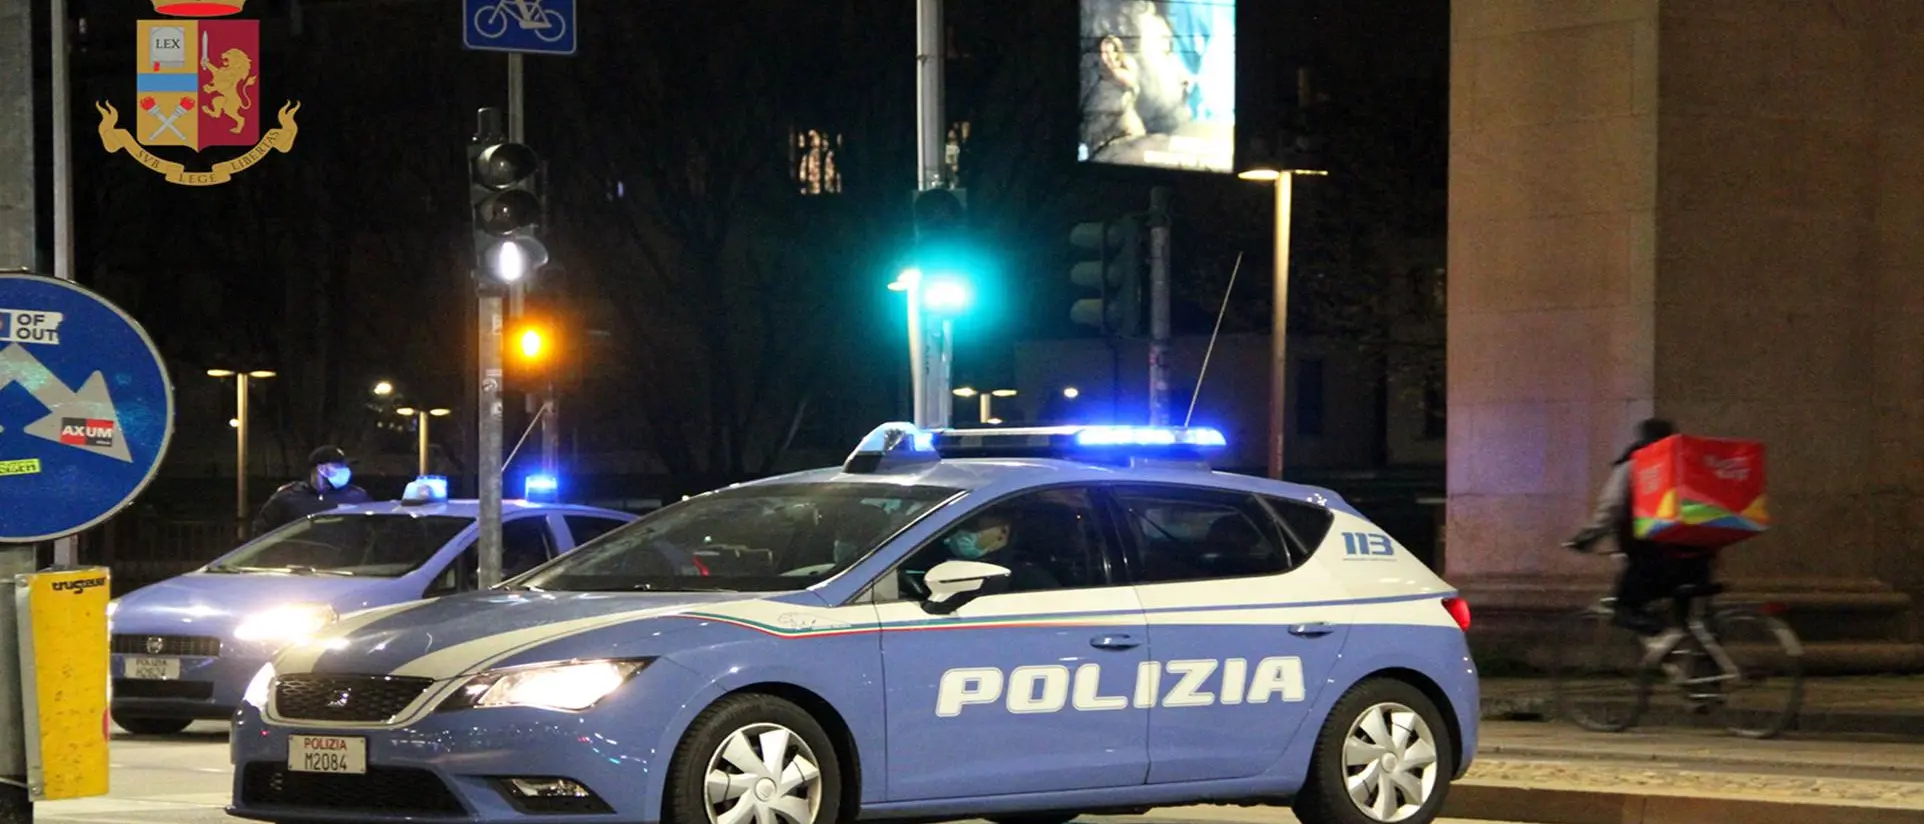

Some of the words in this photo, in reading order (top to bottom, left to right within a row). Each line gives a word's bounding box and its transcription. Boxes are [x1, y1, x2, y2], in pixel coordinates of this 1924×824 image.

[16, 313, 45, 326] OF
[16, 327, 59, 341] OUT
[62, 424, 112, 438] AXUM
[1341, 532, 1394, 556] 113
[935, 655, 1306, 718] POLIZIA
[303, 737, 348, 751] POLIZIA
[304, 752, 348, 771] M2084
